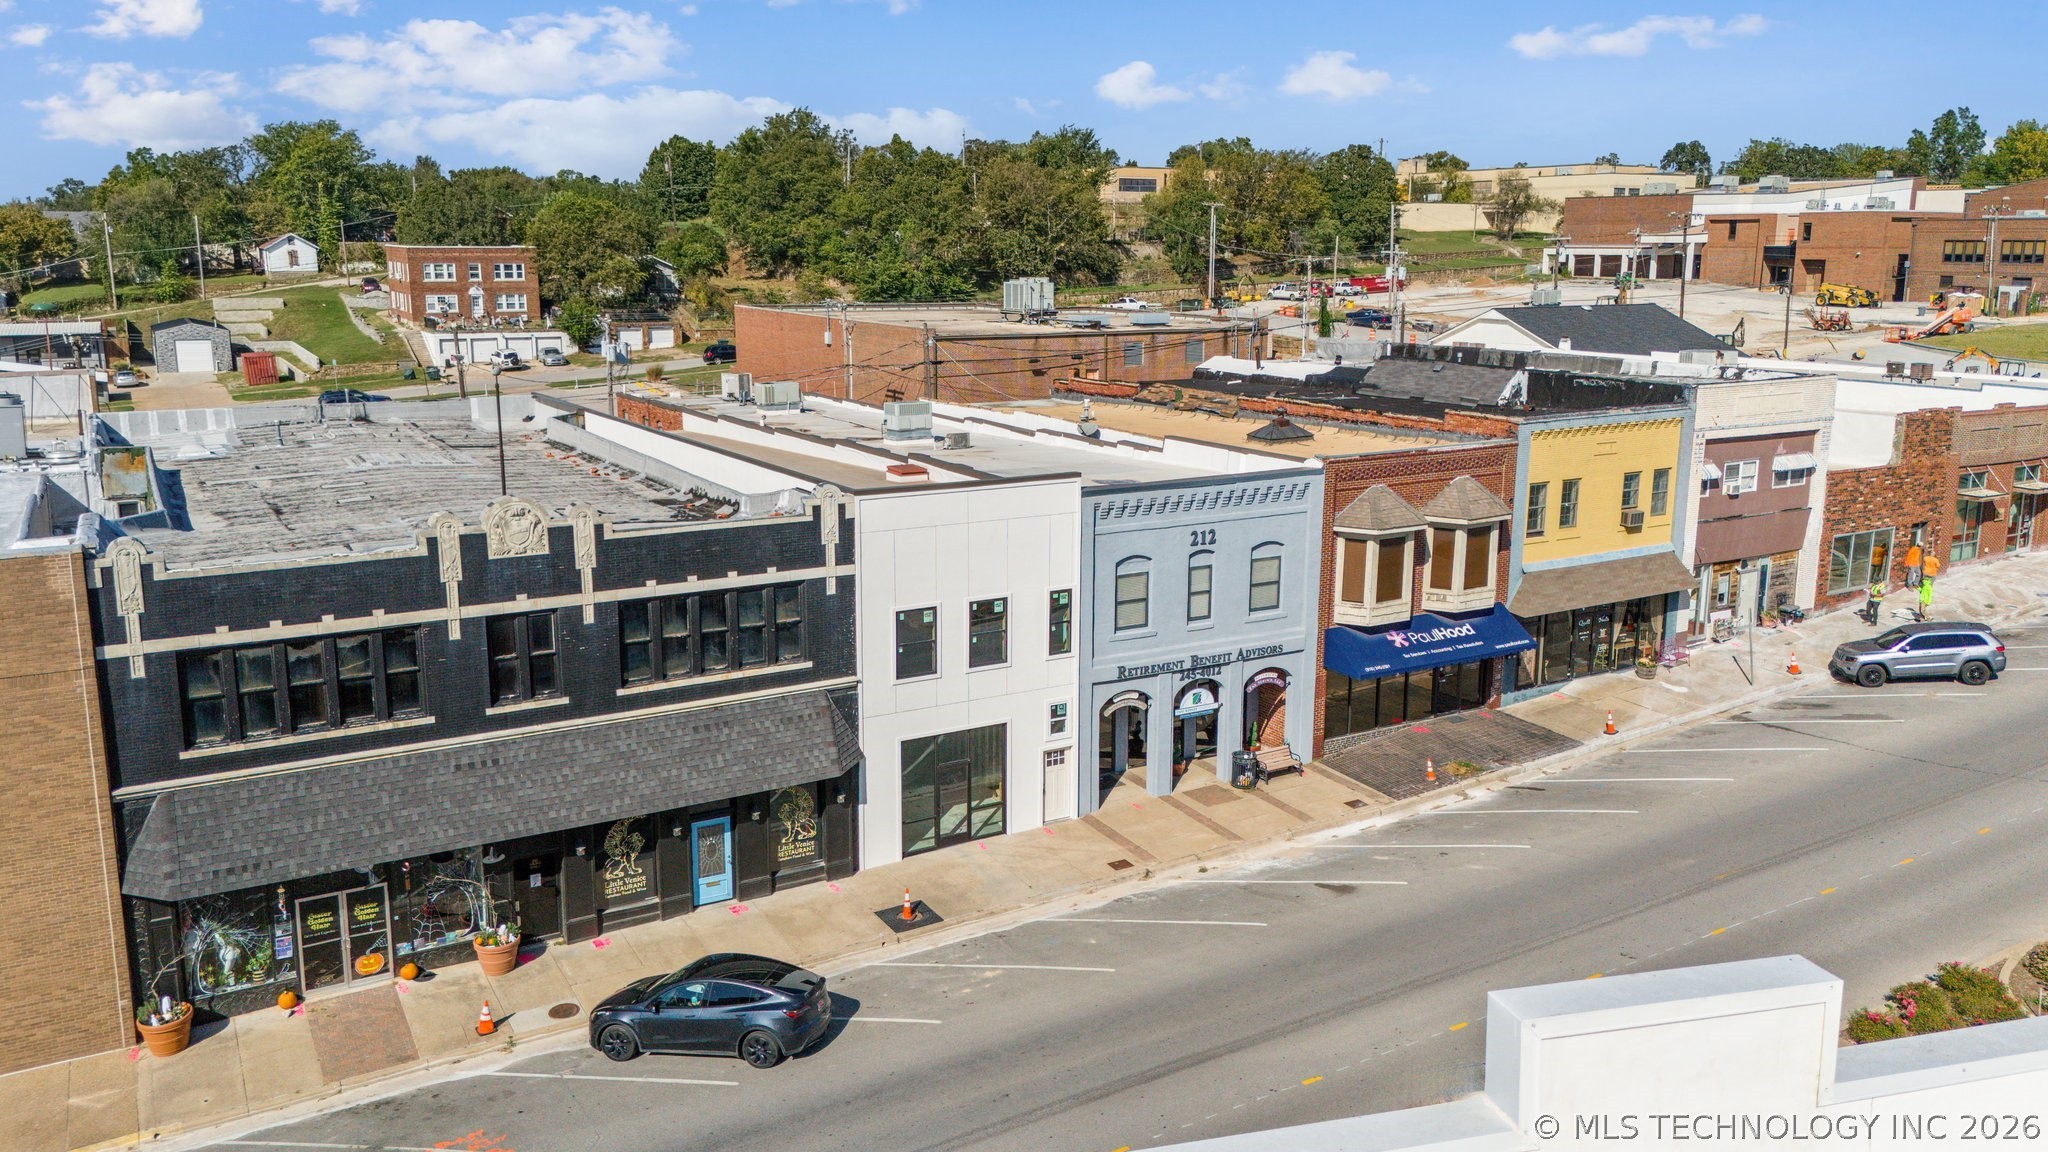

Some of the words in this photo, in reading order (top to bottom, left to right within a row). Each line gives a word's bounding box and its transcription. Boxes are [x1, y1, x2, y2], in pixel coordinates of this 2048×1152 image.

[1190, 529, 1217, 547] 212
[1407, 623, 1476, 645] PaulHood
[1117, 660, 1185, 680] RETIREMENT
[1190, 652, 1232, 668] BENEFIT
[1236, 644, 1284, 661] ADVISORS
[1180, 665, 1223, 682] 245-4012
[778, 843, 795, 852] Little
[795, 840, 815, 848] Venice
[605, 879, 624, 889] Little
[624, 875, 647, 884] Venice
